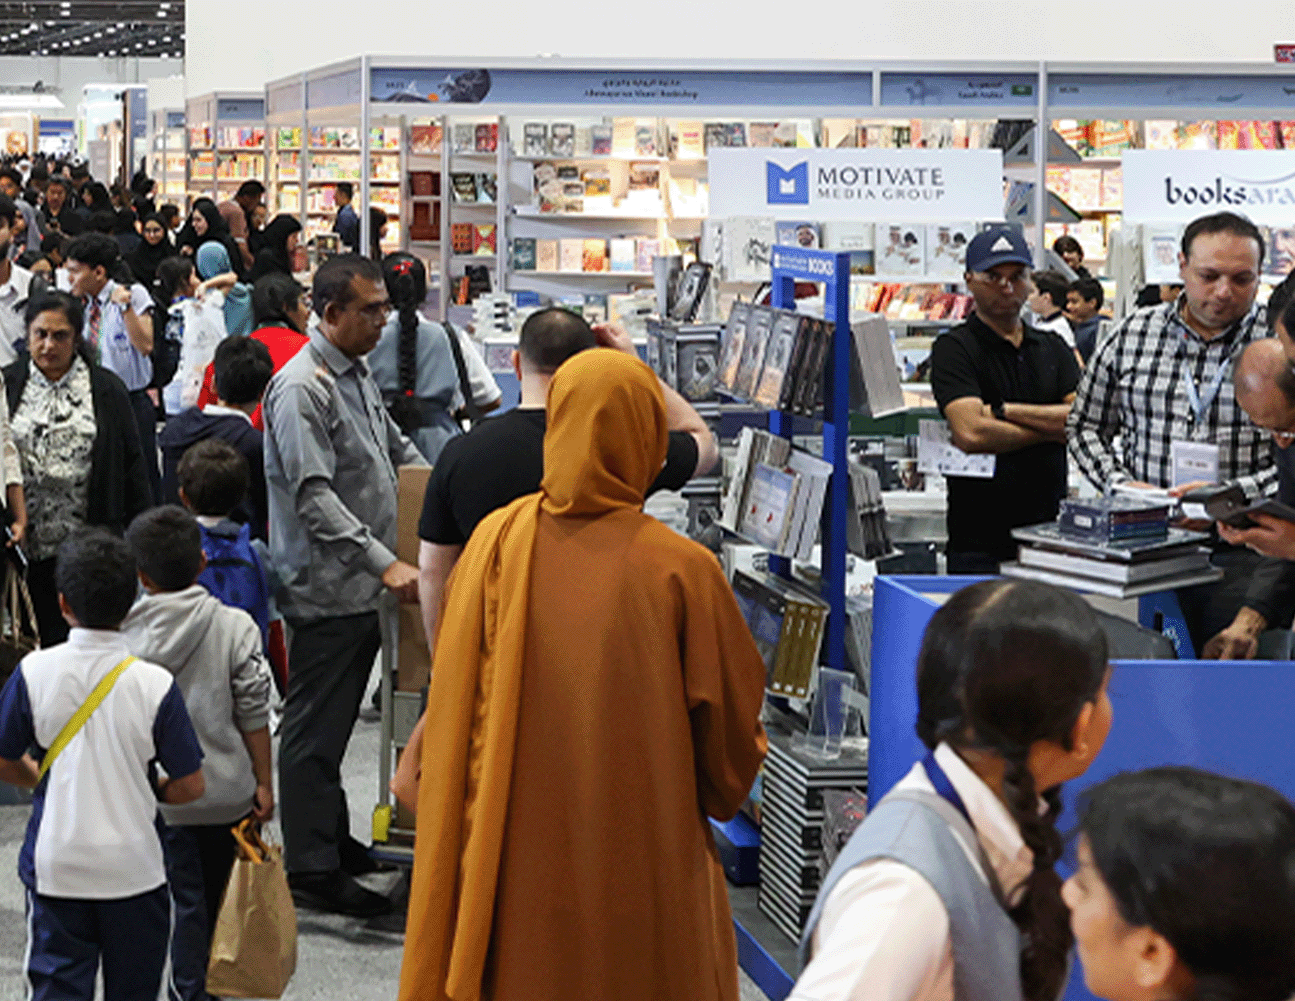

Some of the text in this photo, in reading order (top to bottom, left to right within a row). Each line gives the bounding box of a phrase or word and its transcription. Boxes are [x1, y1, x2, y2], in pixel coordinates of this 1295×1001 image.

[817, 166, 945, 186] MOTIVATE
[817, 187, 945, 201] MEDIA GROUP
